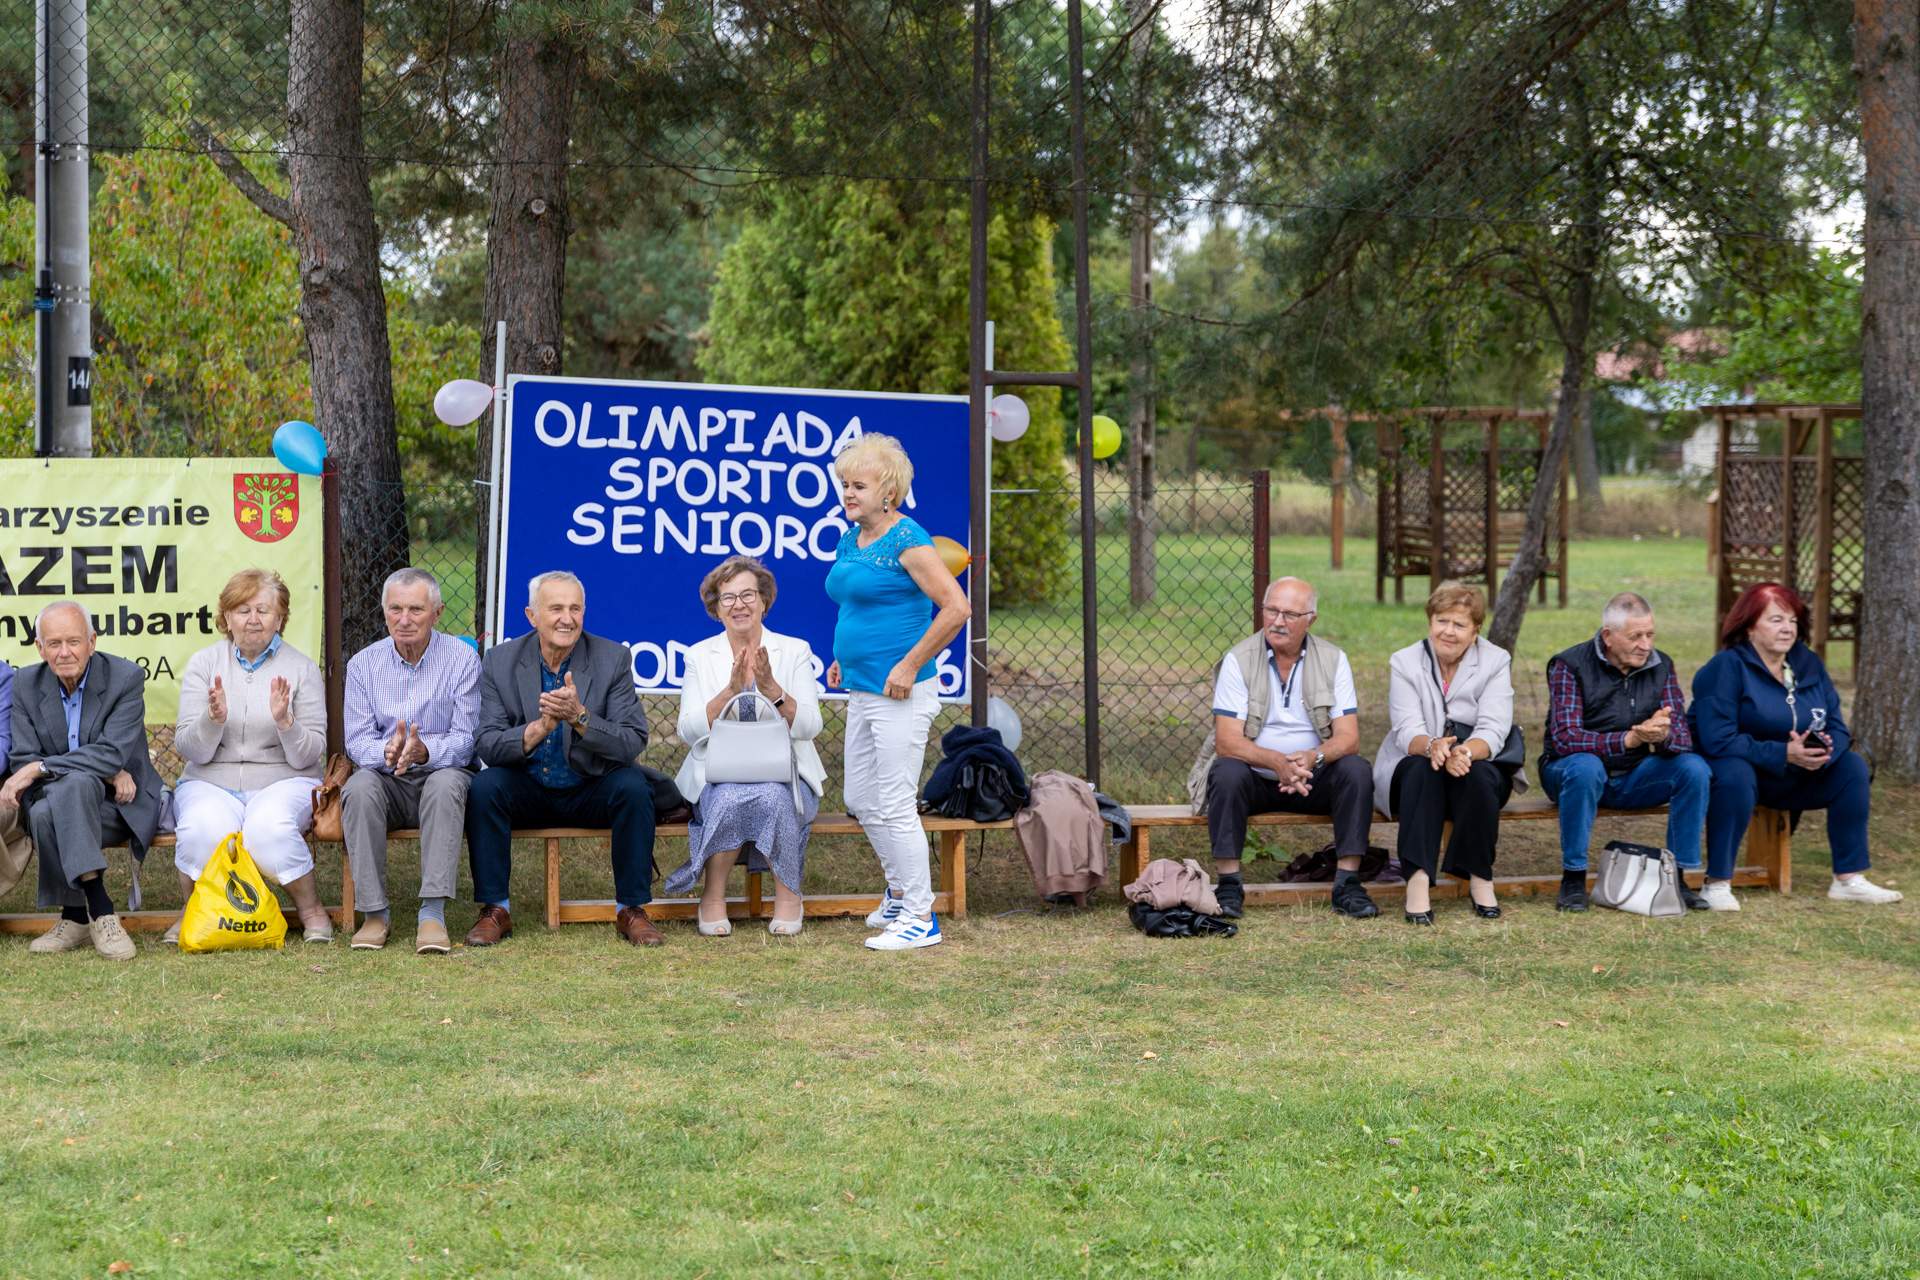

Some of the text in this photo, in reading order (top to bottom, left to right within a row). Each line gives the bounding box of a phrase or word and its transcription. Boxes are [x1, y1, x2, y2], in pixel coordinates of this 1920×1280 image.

[534, 399, 865, 457] OLIMPIADA
[605, 457, 918, 510] SPORTO
[566, 502, 859, 562] SENIORÓ
[90, 604, 213, 636] ubart
[217, 916, 268, 933] Netto
